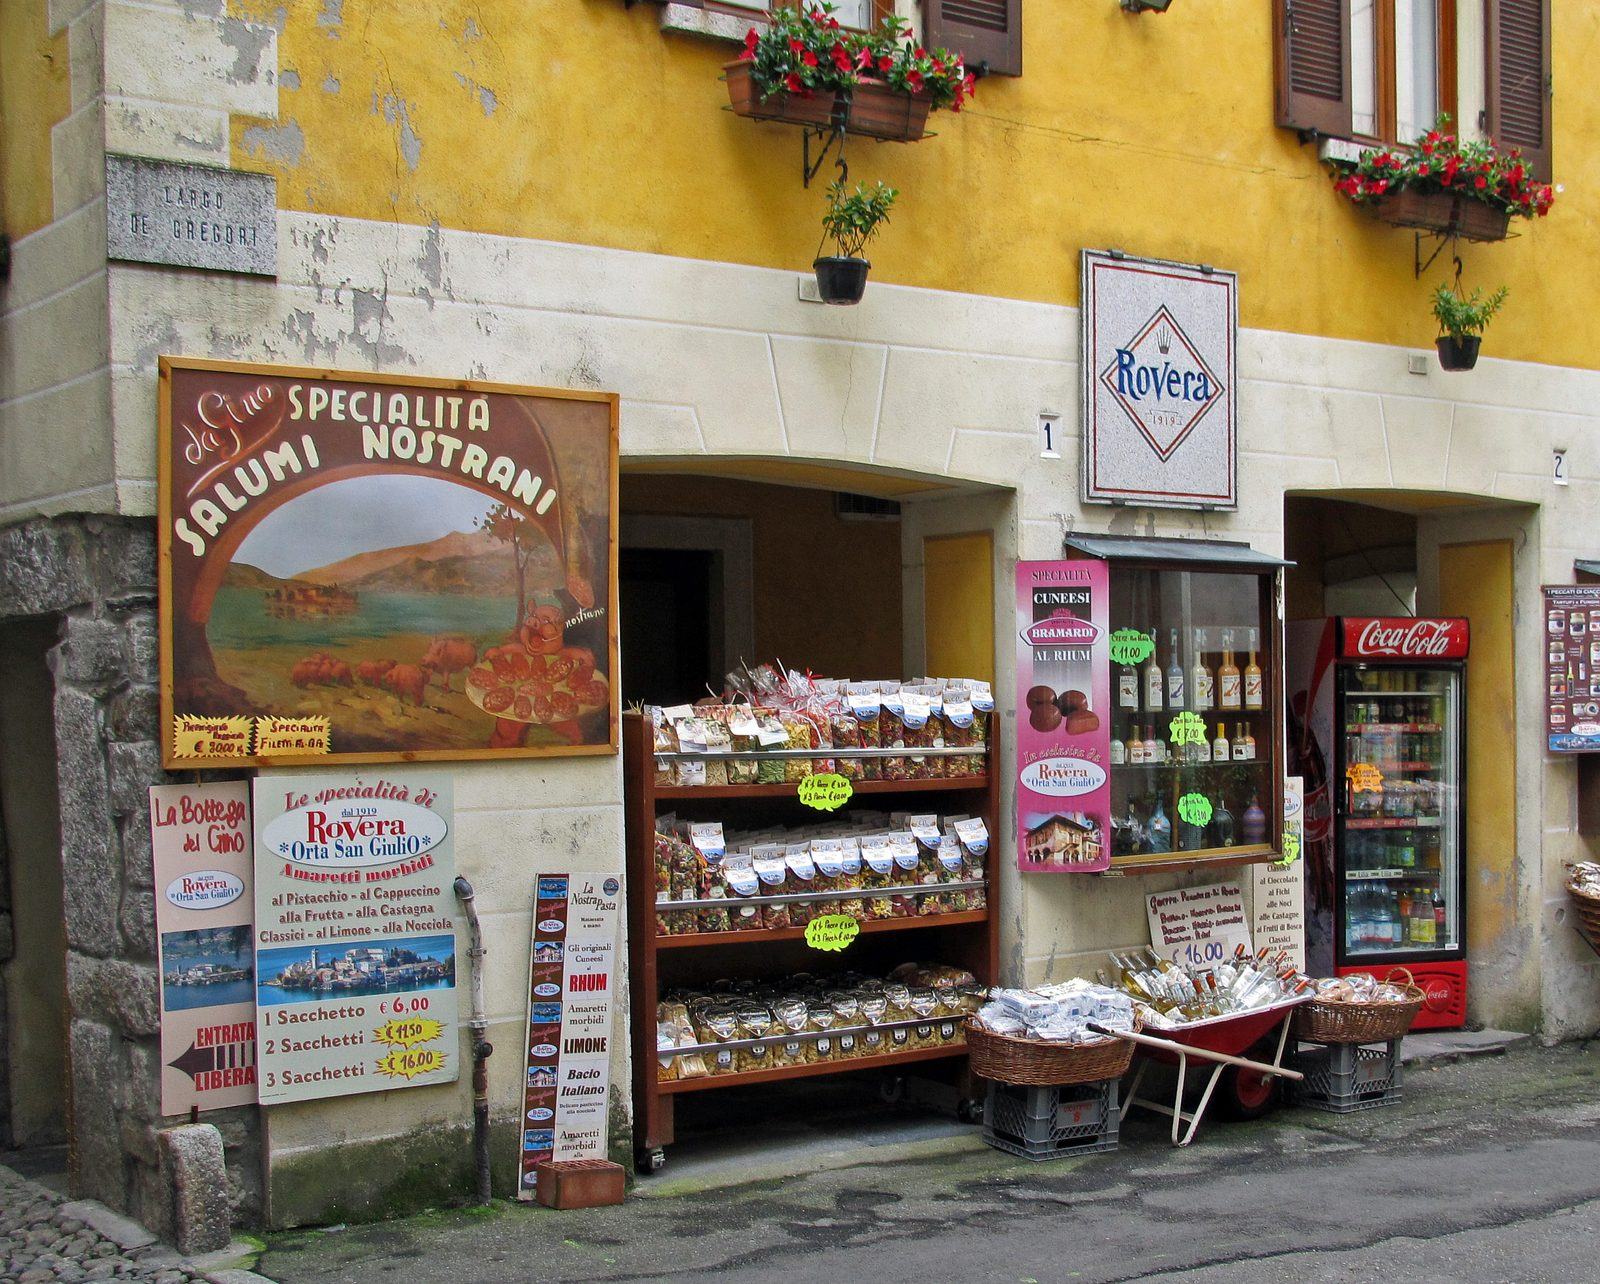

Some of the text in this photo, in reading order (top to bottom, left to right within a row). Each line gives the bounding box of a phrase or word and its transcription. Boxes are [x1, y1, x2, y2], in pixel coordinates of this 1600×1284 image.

[164, 186, 223, 209] LARGO
[130, 213, 257, 246] DE GREGORI
[1044, 422, 1052, 450] 1
[361, 423, 557, 516] NOSTRANI
[1555, 455, 1562, 478] 2
[174, 434, 320, 557] SALUMI
[1032, 568, 1092, 581] SPECIALITÀ
[1033, 592, 1091, 604] CUNEESI
[565, 607, 605, 628] nostrano
[1032, 628, 1093, 638] BRAMARDI
[1358, 620, 1453, 655] Coca-Cola
[1034, 650, 1091, 661] AL RHUM
[1032, 778, 1050, 787] Orta
[1052, 778, 1067, 787] San
[285, 780, 438, 811] Le specialità di
[155, 795, 245, 829] La Bottega
[341, 807, 377, 817] dal 1919
[183, 824, 245, 854] del Gino
[291, 840, 328, 860] Orta
[335, 839, 363, 858] San
[282, 854, 434, 884] Amaretti morbidi
[582, 882, 593, 894] La
[1268, 876, 1298, 884] Cioccolato
[176, 893, 193, 901] Orta
[195, 892, 209, 900] San
[271, 885, 441, 906] al Pistacchio al Cappuccino
[570, 893, 598, 905] Nostra
[279, 903, 434, 924] alla Frutta alla Castagna
[595, 900, 616, 911] Pasta
[1272, 912, 1299, 920] Castagne
[259, 918, 453, 943] Classici al Limone alla Nocciola
[1268, 936, 1291, 944] Classici
[568, 943, 611, 954] Gli originali
[1185, 941, 1223, 965] 16.00
[575, 955, 603, 963] Cuneesi
[569, 973, 607, 992] RHUM
[264, 996, 429, 1026] 1 Sacchetto € 6,00
[568, 1003, 607, 1013] Amaretti
[569, 1015, 604, 1025] morbidi
[197, 1021, 255, 1047] ENTRATA
[265, 1040, 275, 1054] 2
[281, 1030, 364, 1053] Sacchetti
[563, 1037, 607, 1054] LIMONE
[195, 1066, 256, 1092] LIBERA
[266, 1072, 276, 1087] 3
[281, 1062, 365, 1086] Sacchetti
[567, 1068, 601, 1080] Bacio
[560, 1085, 605, 1097] Italiano
[560, 1129, 599, 1139] Amaretti
[561, 1141, 596, 1151] morbidi
